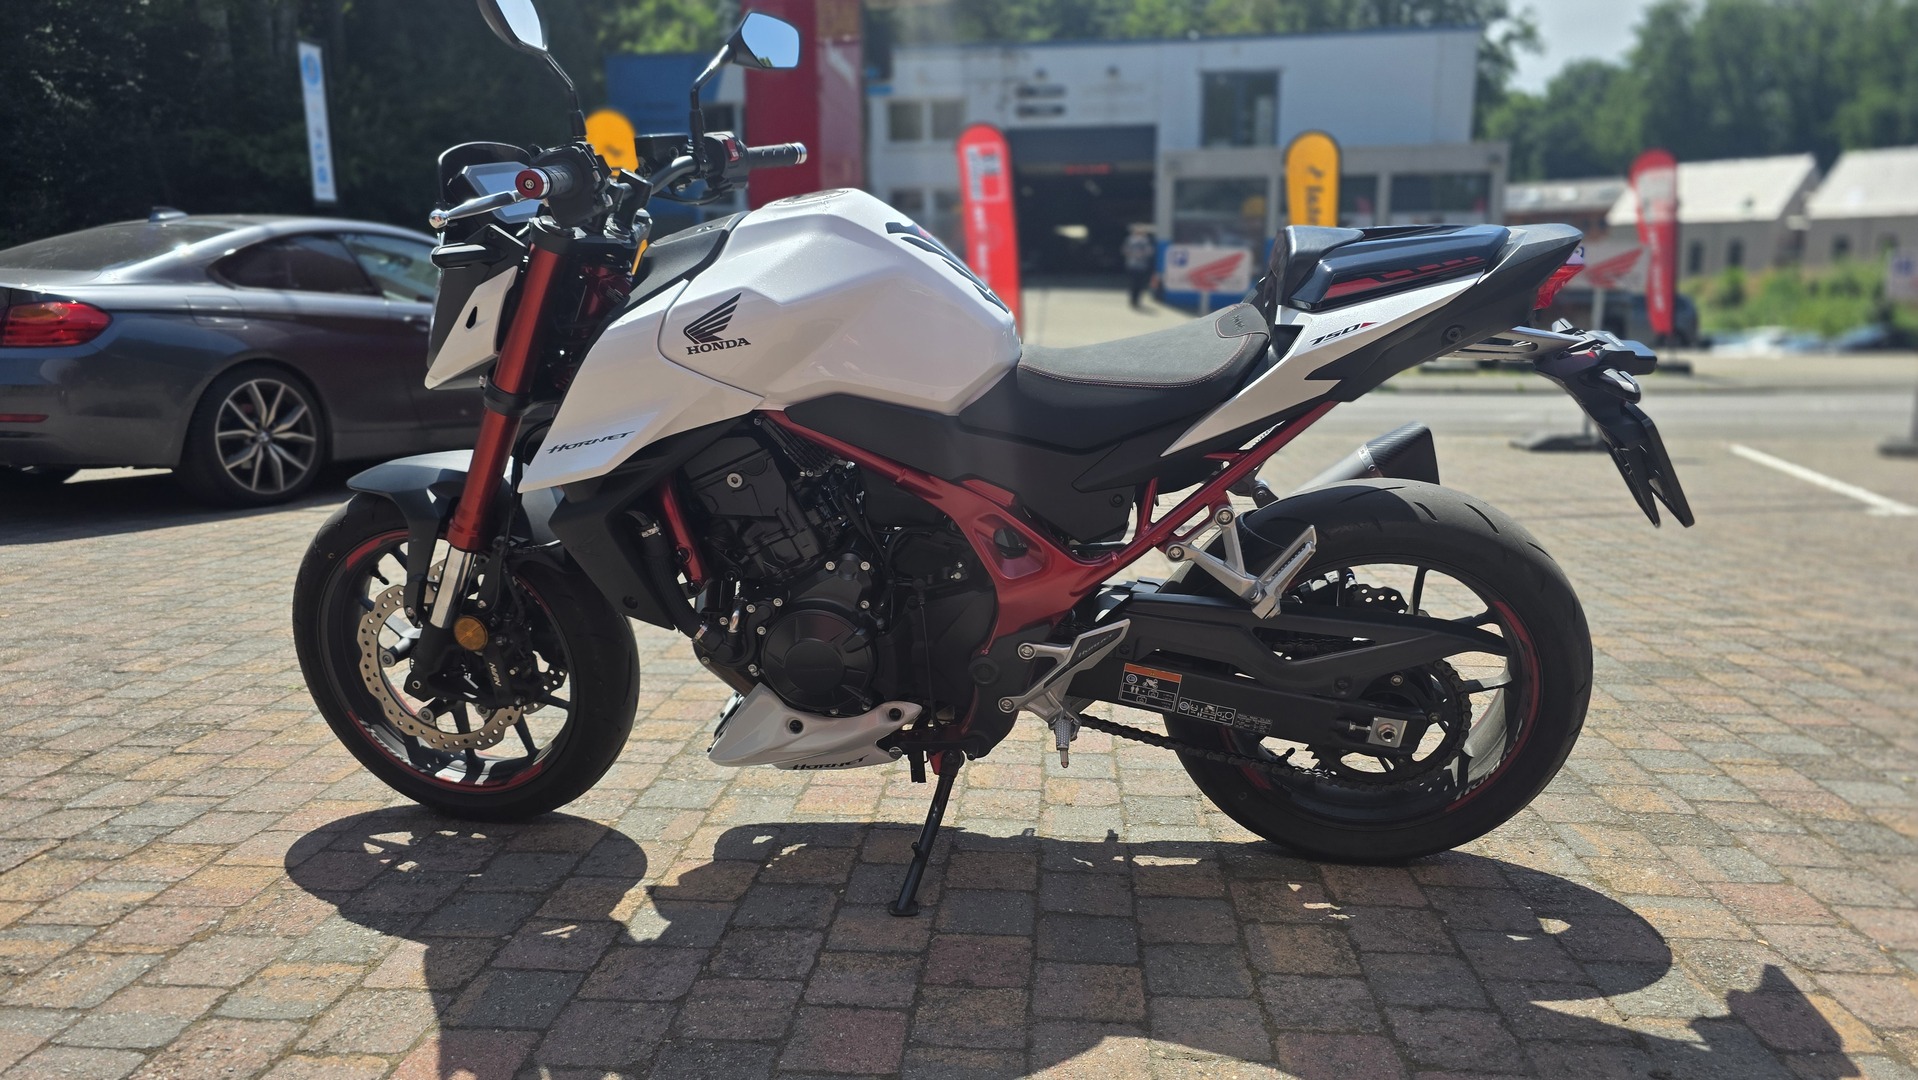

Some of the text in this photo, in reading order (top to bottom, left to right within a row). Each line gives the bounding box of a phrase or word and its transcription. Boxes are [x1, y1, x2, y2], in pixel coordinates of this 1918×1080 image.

[1309, 323, 1361, 346] 750
[686, 337, 751, 355] HONDA
[546, 431, 635, 454] HORNET
[790, 754, 870, 770] HORNET
